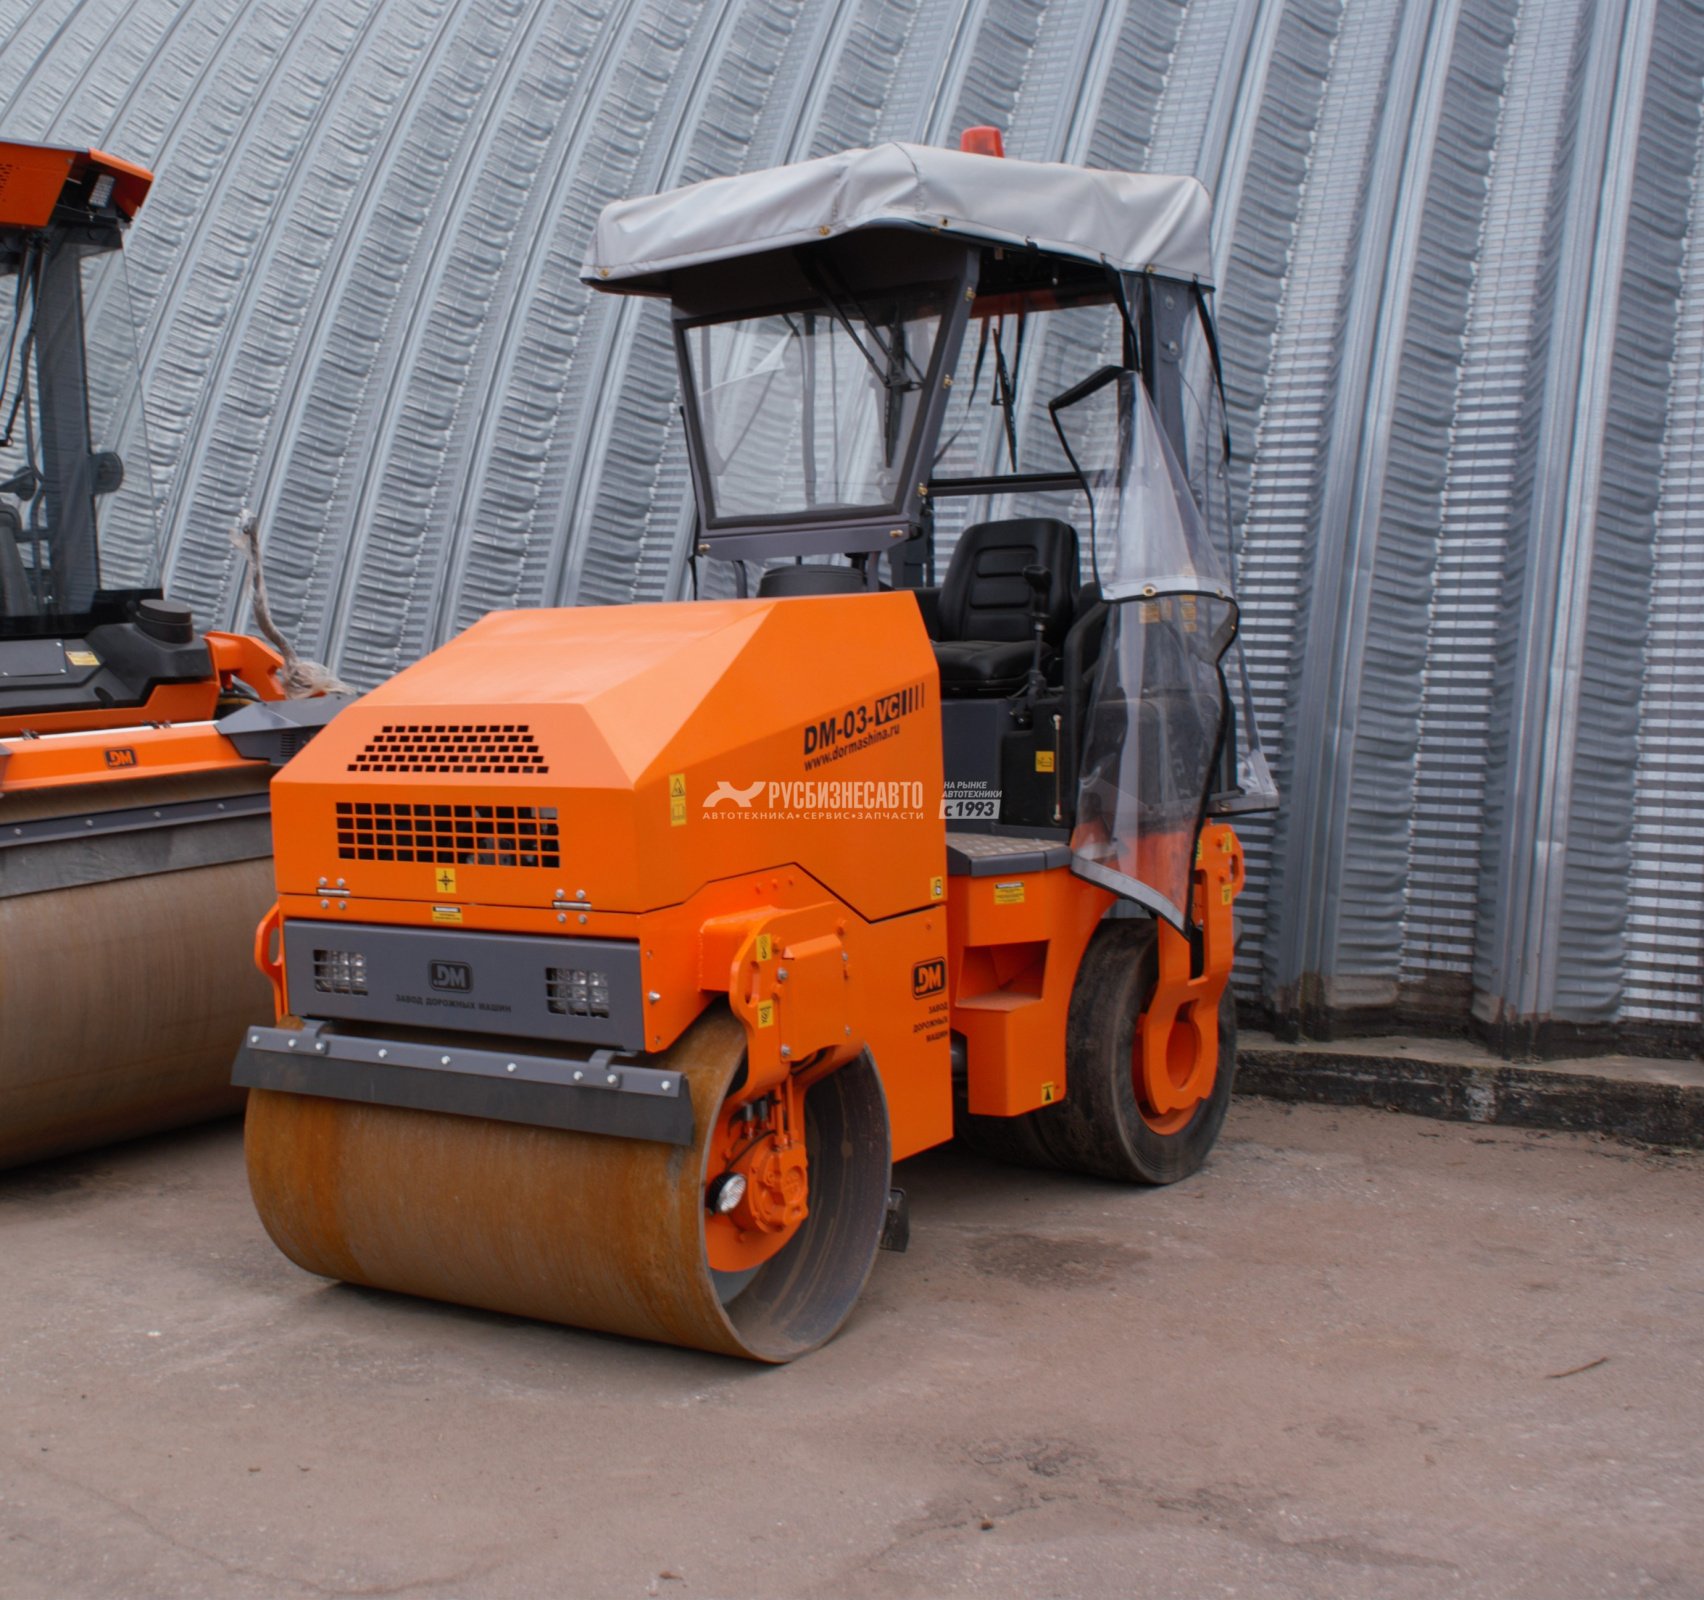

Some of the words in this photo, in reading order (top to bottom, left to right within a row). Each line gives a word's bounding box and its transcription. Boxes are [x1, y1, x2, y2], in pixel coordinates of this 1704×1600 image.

[804, 723, 901, 771] www.dormashina.ru
[395, 994, 423, 1005] ЗАВОД
[426, 998, 475, 1010] ДОРОЖНЫХ
